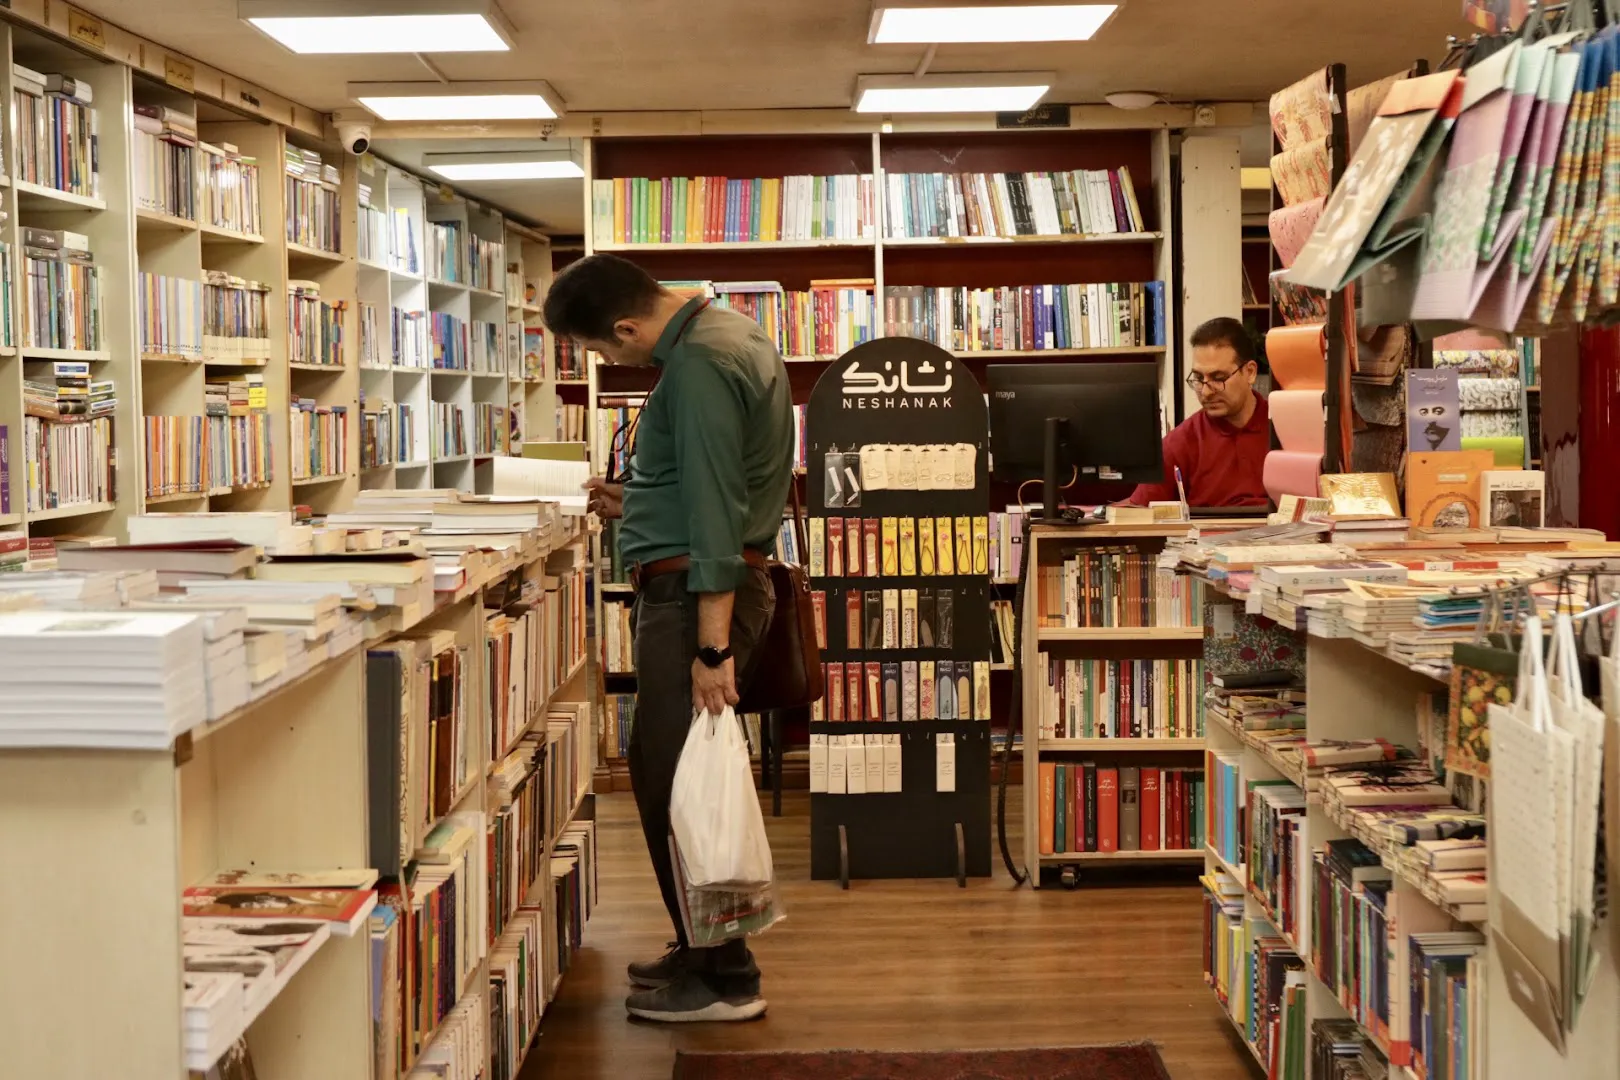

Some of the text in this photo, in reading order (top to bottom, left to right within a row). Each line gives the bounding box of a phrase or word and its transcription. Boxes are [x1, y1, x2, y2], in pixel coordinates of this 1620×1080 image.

[842, 360, 953, 393] نشانک
[995, 391, 1015, 400] maya
[843, 397, 952, 409] NESHANAK
